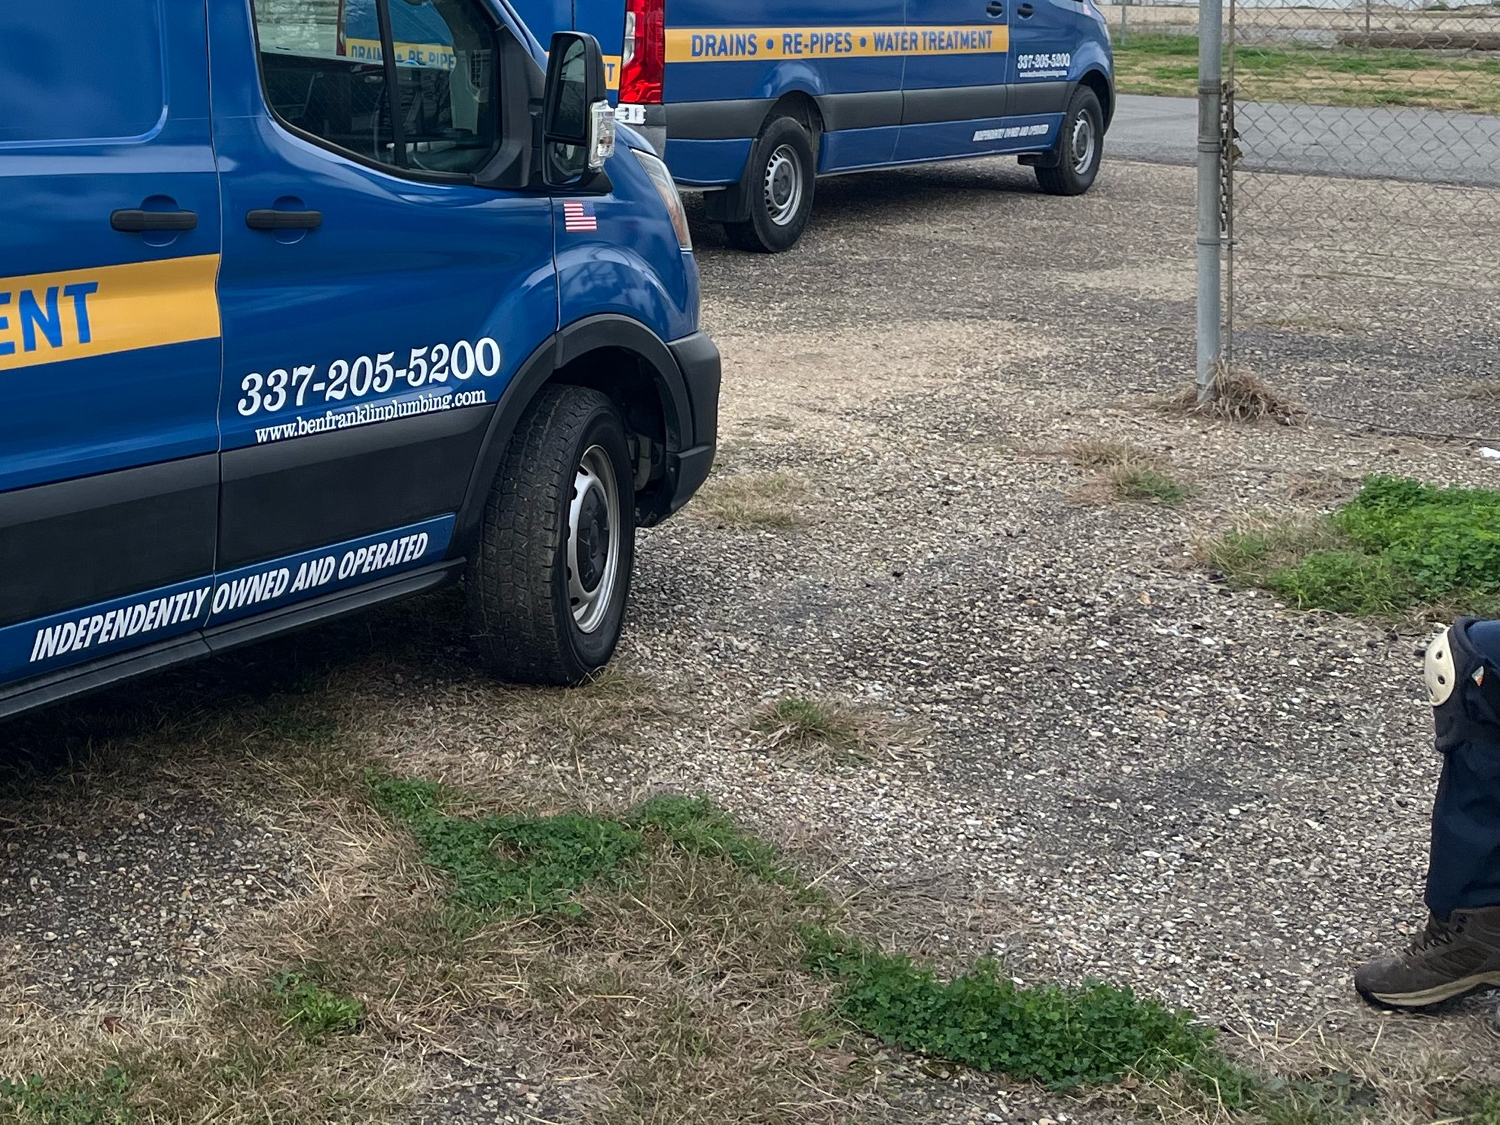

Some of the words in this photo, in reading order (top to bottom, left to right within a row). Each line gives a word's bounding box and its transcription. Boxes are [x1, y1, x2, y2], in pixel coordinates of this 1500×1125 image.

[691, 33, 758, 57] DRAINS
[782, 32, 853, 55] RE-PIPES
[873, 31, 919, 52] WATER
[920, 30, 993, 50] TREATMENT
[237, 337, 501, 416] 337-205-5200
[255, 388, 487, 443] www.benfranklinplumbing.com
[29, 586, 211, 663] INDEPENDENTLY
[212, 567, 290, 614] OWNED
[290, 556, 336, 593] AND
[338, 532, 429, 580] OPERATED
